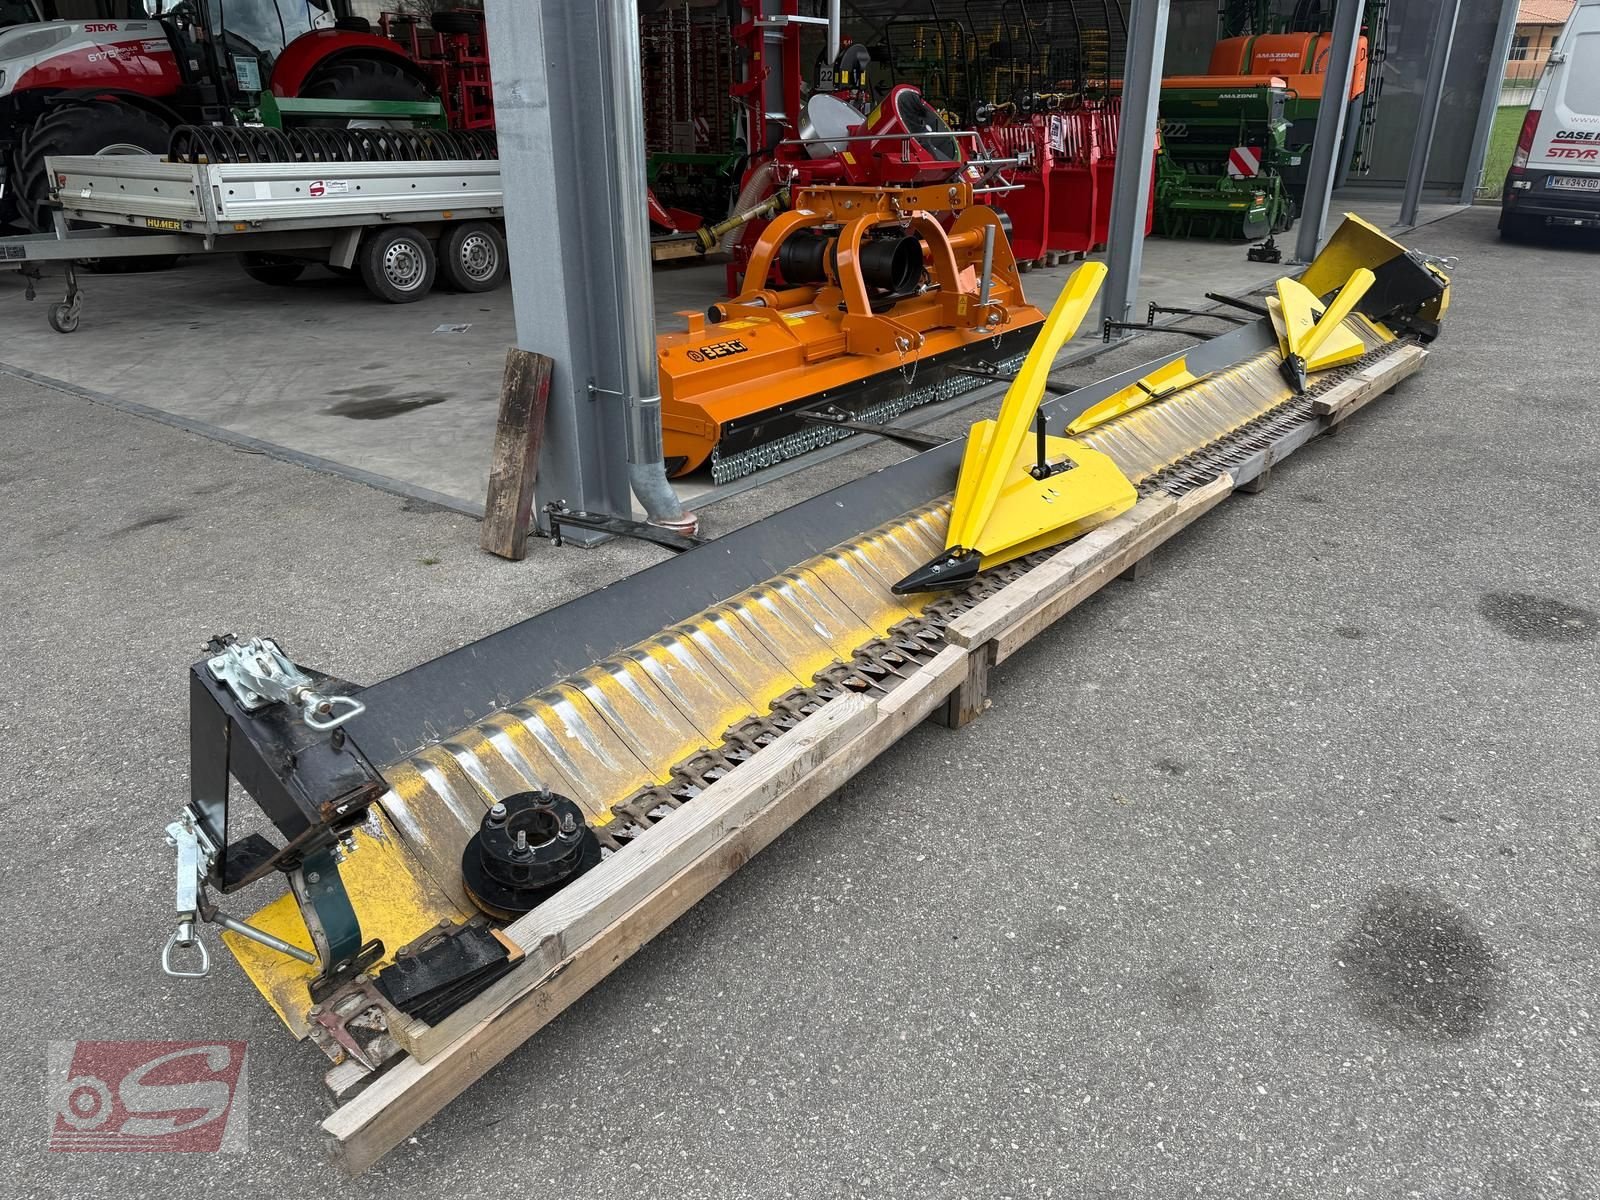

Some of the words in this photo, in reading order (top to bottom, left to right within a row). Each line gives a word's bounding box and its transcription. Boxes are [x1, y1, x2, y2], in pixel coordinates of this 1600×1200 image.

[84, 23, 119, 33] STEYR
[88, 49, 117, 62] 6175
[821, 70, 833, 81] 22
[1556, 130, 1595, 140] CASE
[1545, 148, 1599, 159] STEYR
[147, 219, 181, 230] HUMER
